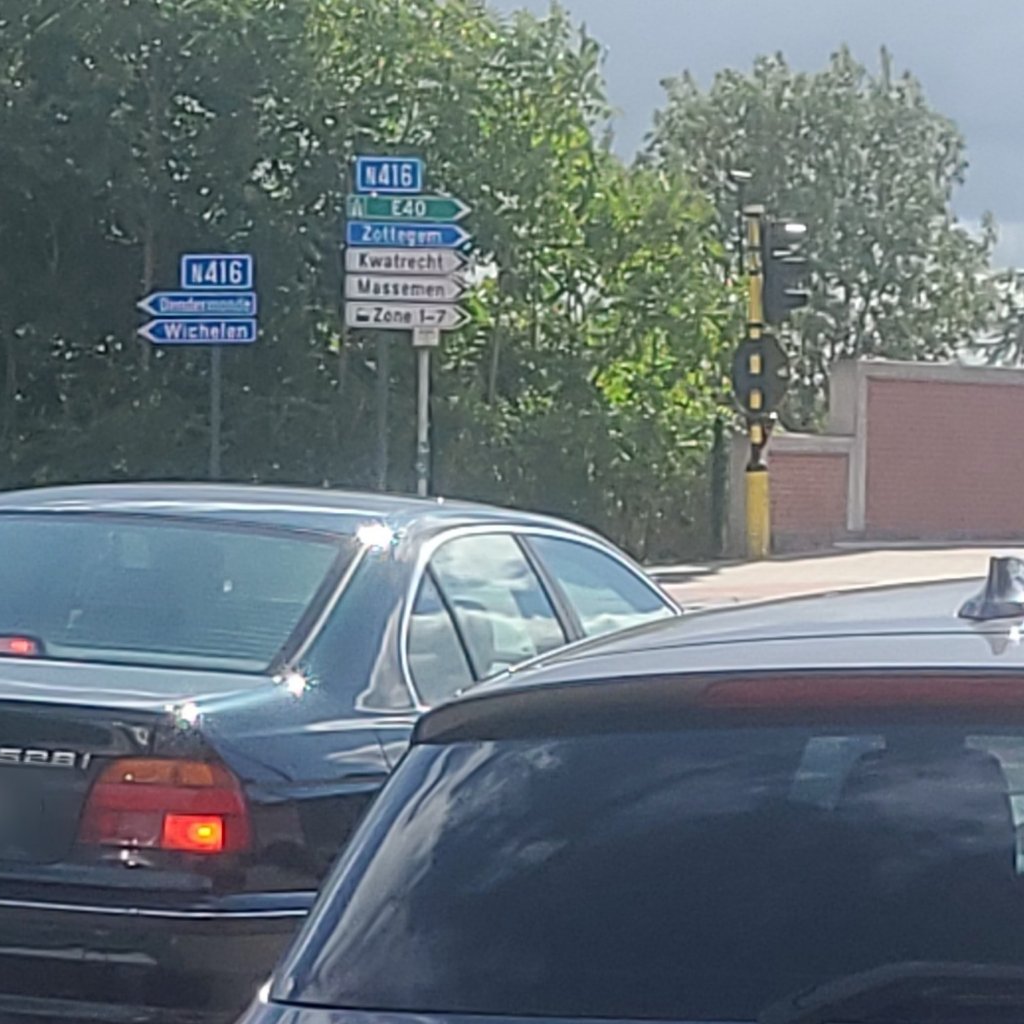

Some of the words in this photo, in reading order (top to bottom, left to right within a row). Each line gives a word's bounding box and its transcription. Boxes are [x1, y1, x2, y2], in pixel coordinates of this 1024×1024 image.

[365, 162, 413, 187] N416
[391, 199, 427, 217] E40
[358, 252, 443, 270] Kwatrecht
[191, 260, 243, 284] N416
[358, 278, 445, 297] Massemen
[373, 306, 412, 323] Zone
[164, 322, 249, 340] Wichelen
